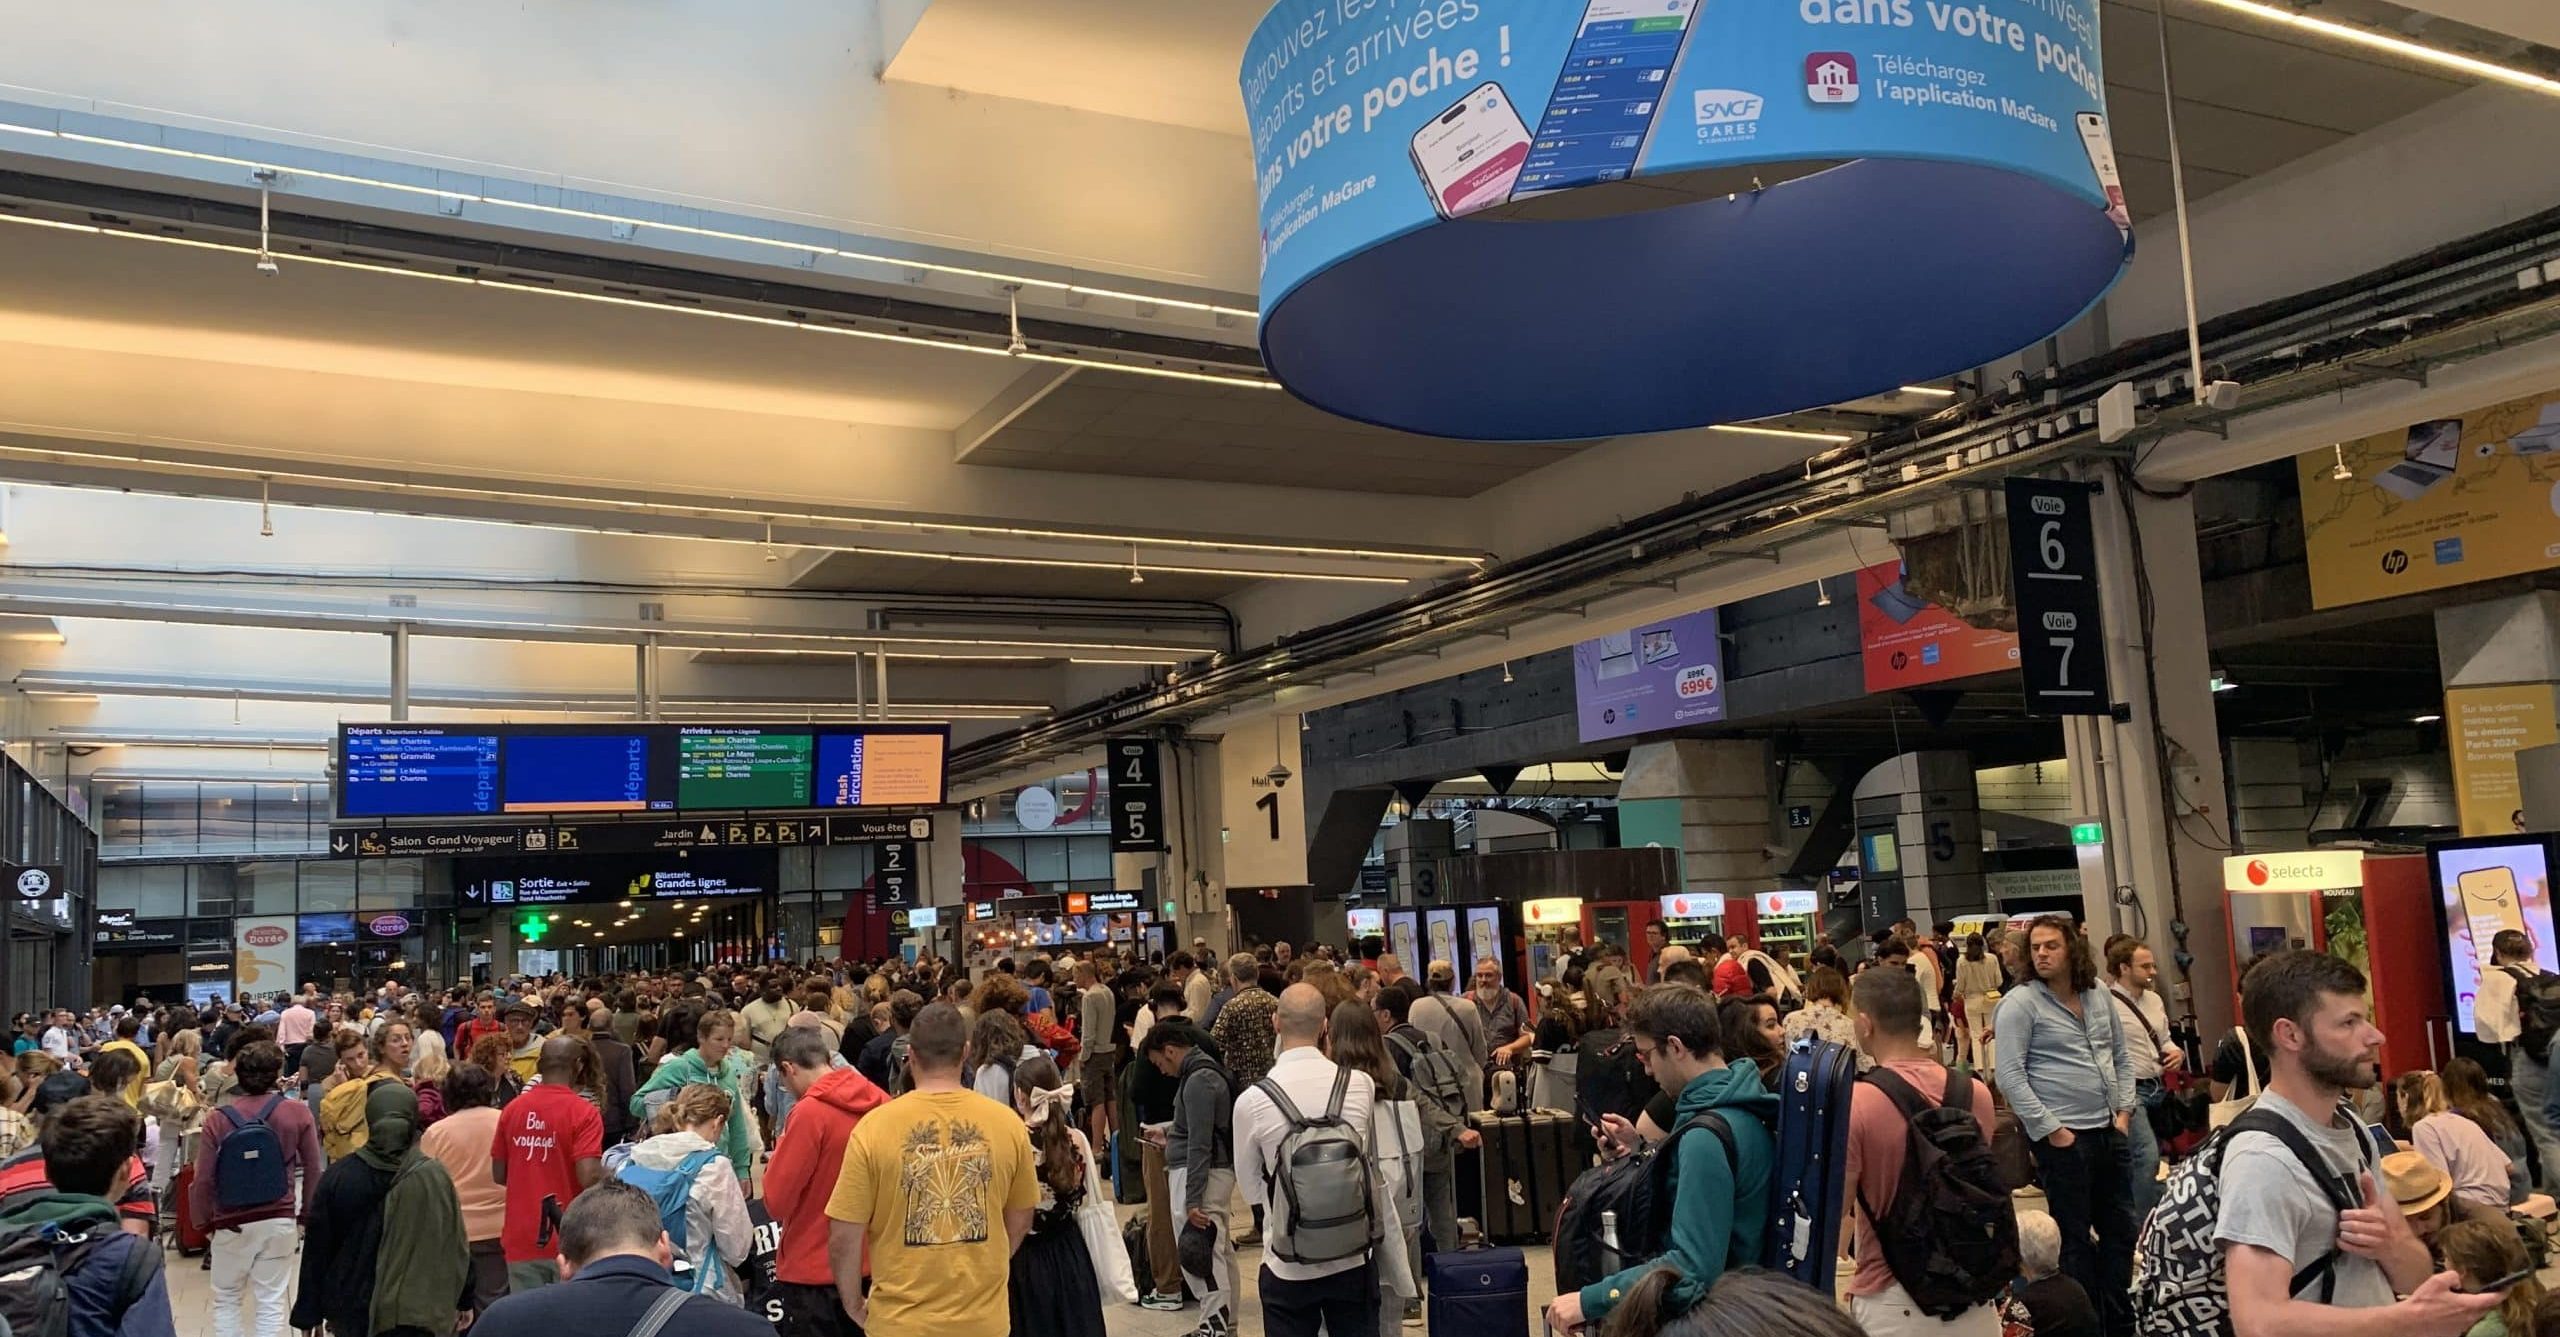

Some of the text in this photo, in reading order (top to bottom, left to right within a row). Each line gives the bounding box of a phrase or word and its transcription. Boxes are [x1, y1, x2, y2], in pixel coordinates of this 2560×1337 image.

[1311, 54, 1337, 97] et
[1344, 0, 1480, 76] arrivées
[1926, 0, 2025, 52] votre
[2035, 32, 2099, 100] poche
[1872, 53, 1988, 88] Téléchargez
[1286, 104, 1352, 169] votre
[1363, 46, 1481, 133] poche
[1700, 98, 1759, 120] SNCF
[2001, 97, 2059, 133] MaGare
[1696, 121, 1757, 139] GARES
[1321, 174, 1377, 214] MaGare
[2035, 499, 2062, 512] Voie
[2039, 520, 2067, 571] 6
[2383, 551, 2408, 575] hp
[2047, 614, 2074, 628] Voie
[2049, 637, 2075, 687] 7
[1681, 676, 1714, 696] 699€
[347, 727, 382, 736] Départs
[680, 727, 712, 735] Arrivées
[400, 752, 435, 760] Granville
[737, 750, 755, 758] Mans
[624, 738, 644, 802] départs
[849, 738, 863, 805] circulation
[1126, 757, 1143, 782] 4
[836, 774, 849, 805] flash
[1252, 776, 1270, 788] Hall
[1255, 791, 1280, 840] 1
[661, 829, 694, 839] Jardin
[754, 826, 772, 841] P4
[778, 825, 797, 841] P5
[862, 822, 906, 833] Vous êtes
[1129, 814, 1145, 839] 5
[390, 833, 514, 848] Salon Grand Voyageur
[558, 831, 577, 847] P1
[1931, 821, 1956, 862] 5
[888, 852, 901, 869] 2
[655, 871, 691, 879] Billetterie
[2271, 864, 2324, 879] selecta
[520, 877, 554, 888] Sortie
[655, 878, 727, 889] Grandes lignes
[889, 885, 901, 902] 3
[2323, 888, 2355, 897] NOUVEAU
[1690, 902, 1717, 910] selecta
[249, 935, 285, 944] Dorée
[526, 1111, 546, 1130] Bon
[512, 1131, 556, 1162] voyage!
[914, 1142, 982, 1162] Sunshine
